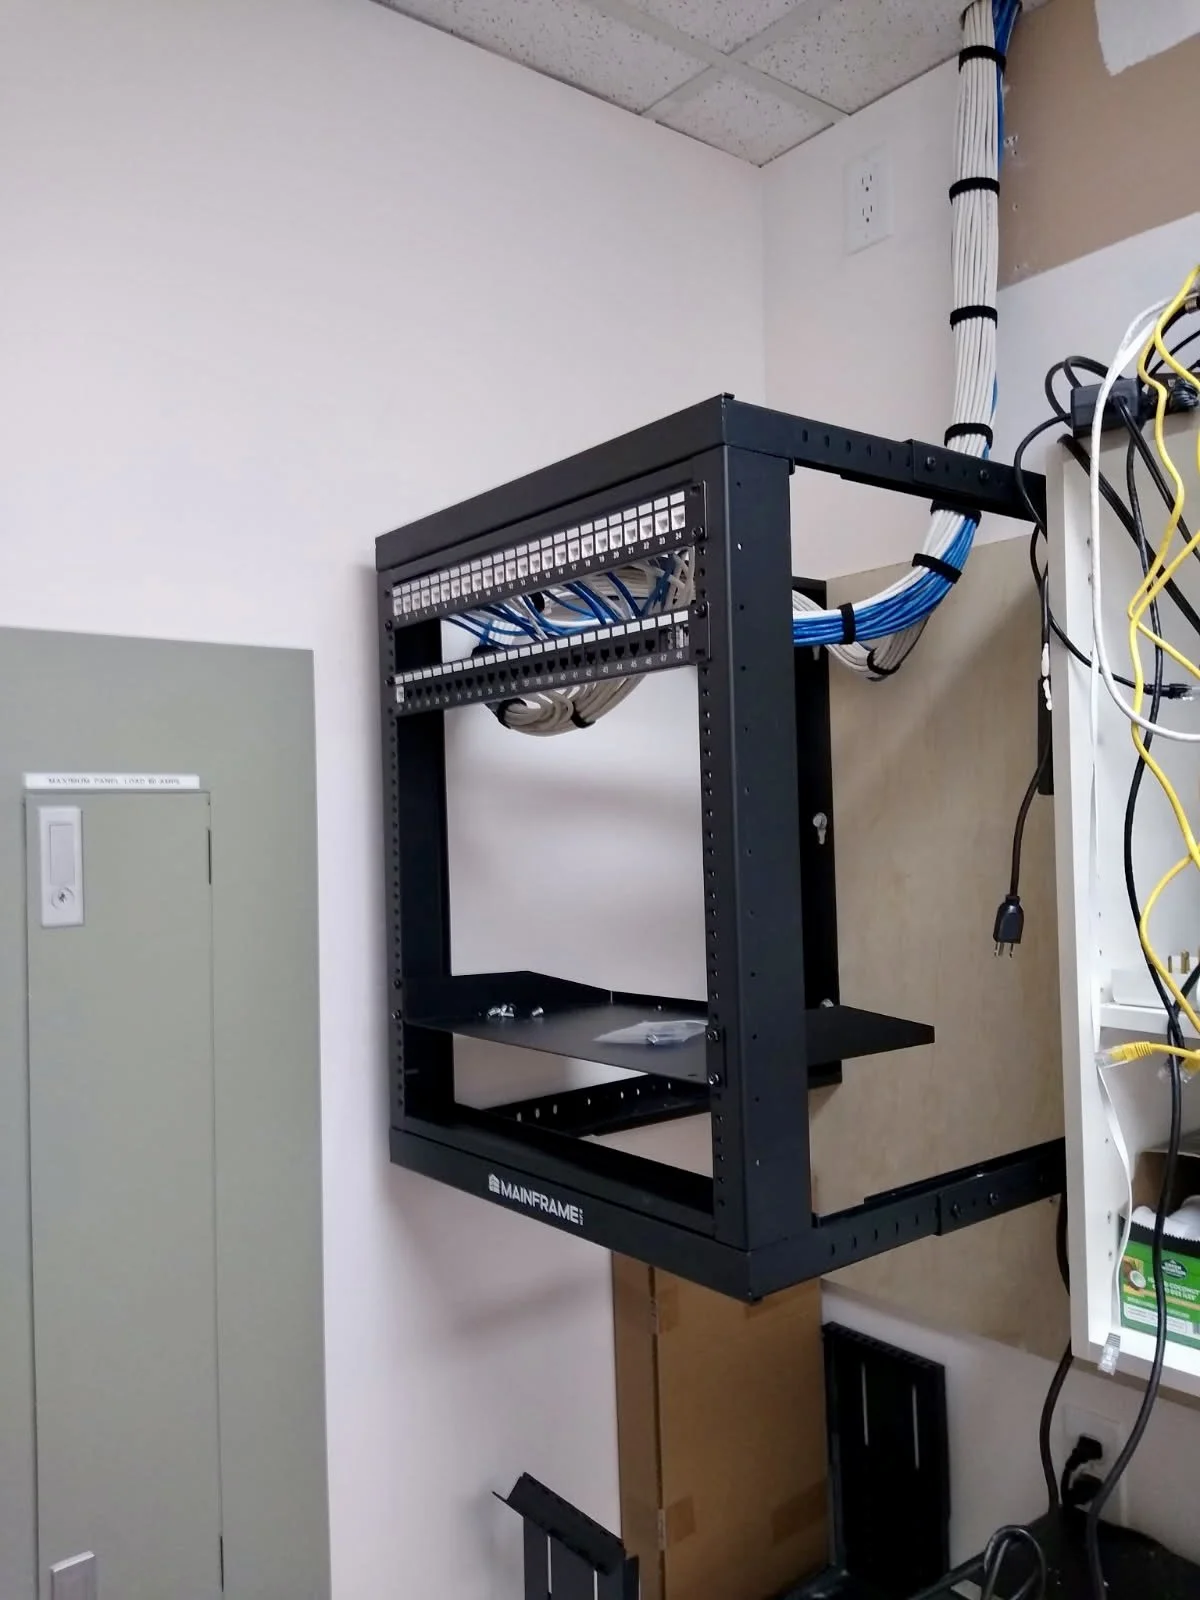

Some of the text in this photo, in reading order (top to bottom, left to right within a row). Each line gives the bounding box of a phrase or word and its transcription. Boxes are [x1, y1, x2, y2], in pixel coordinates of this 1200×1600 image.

[676, 532, 682, 540] 24
[94, 777, 119, 785] PANEL
[124, 777, 146, 785] LOAD
[500, 1180, 580, 1225] MAINFRAME
